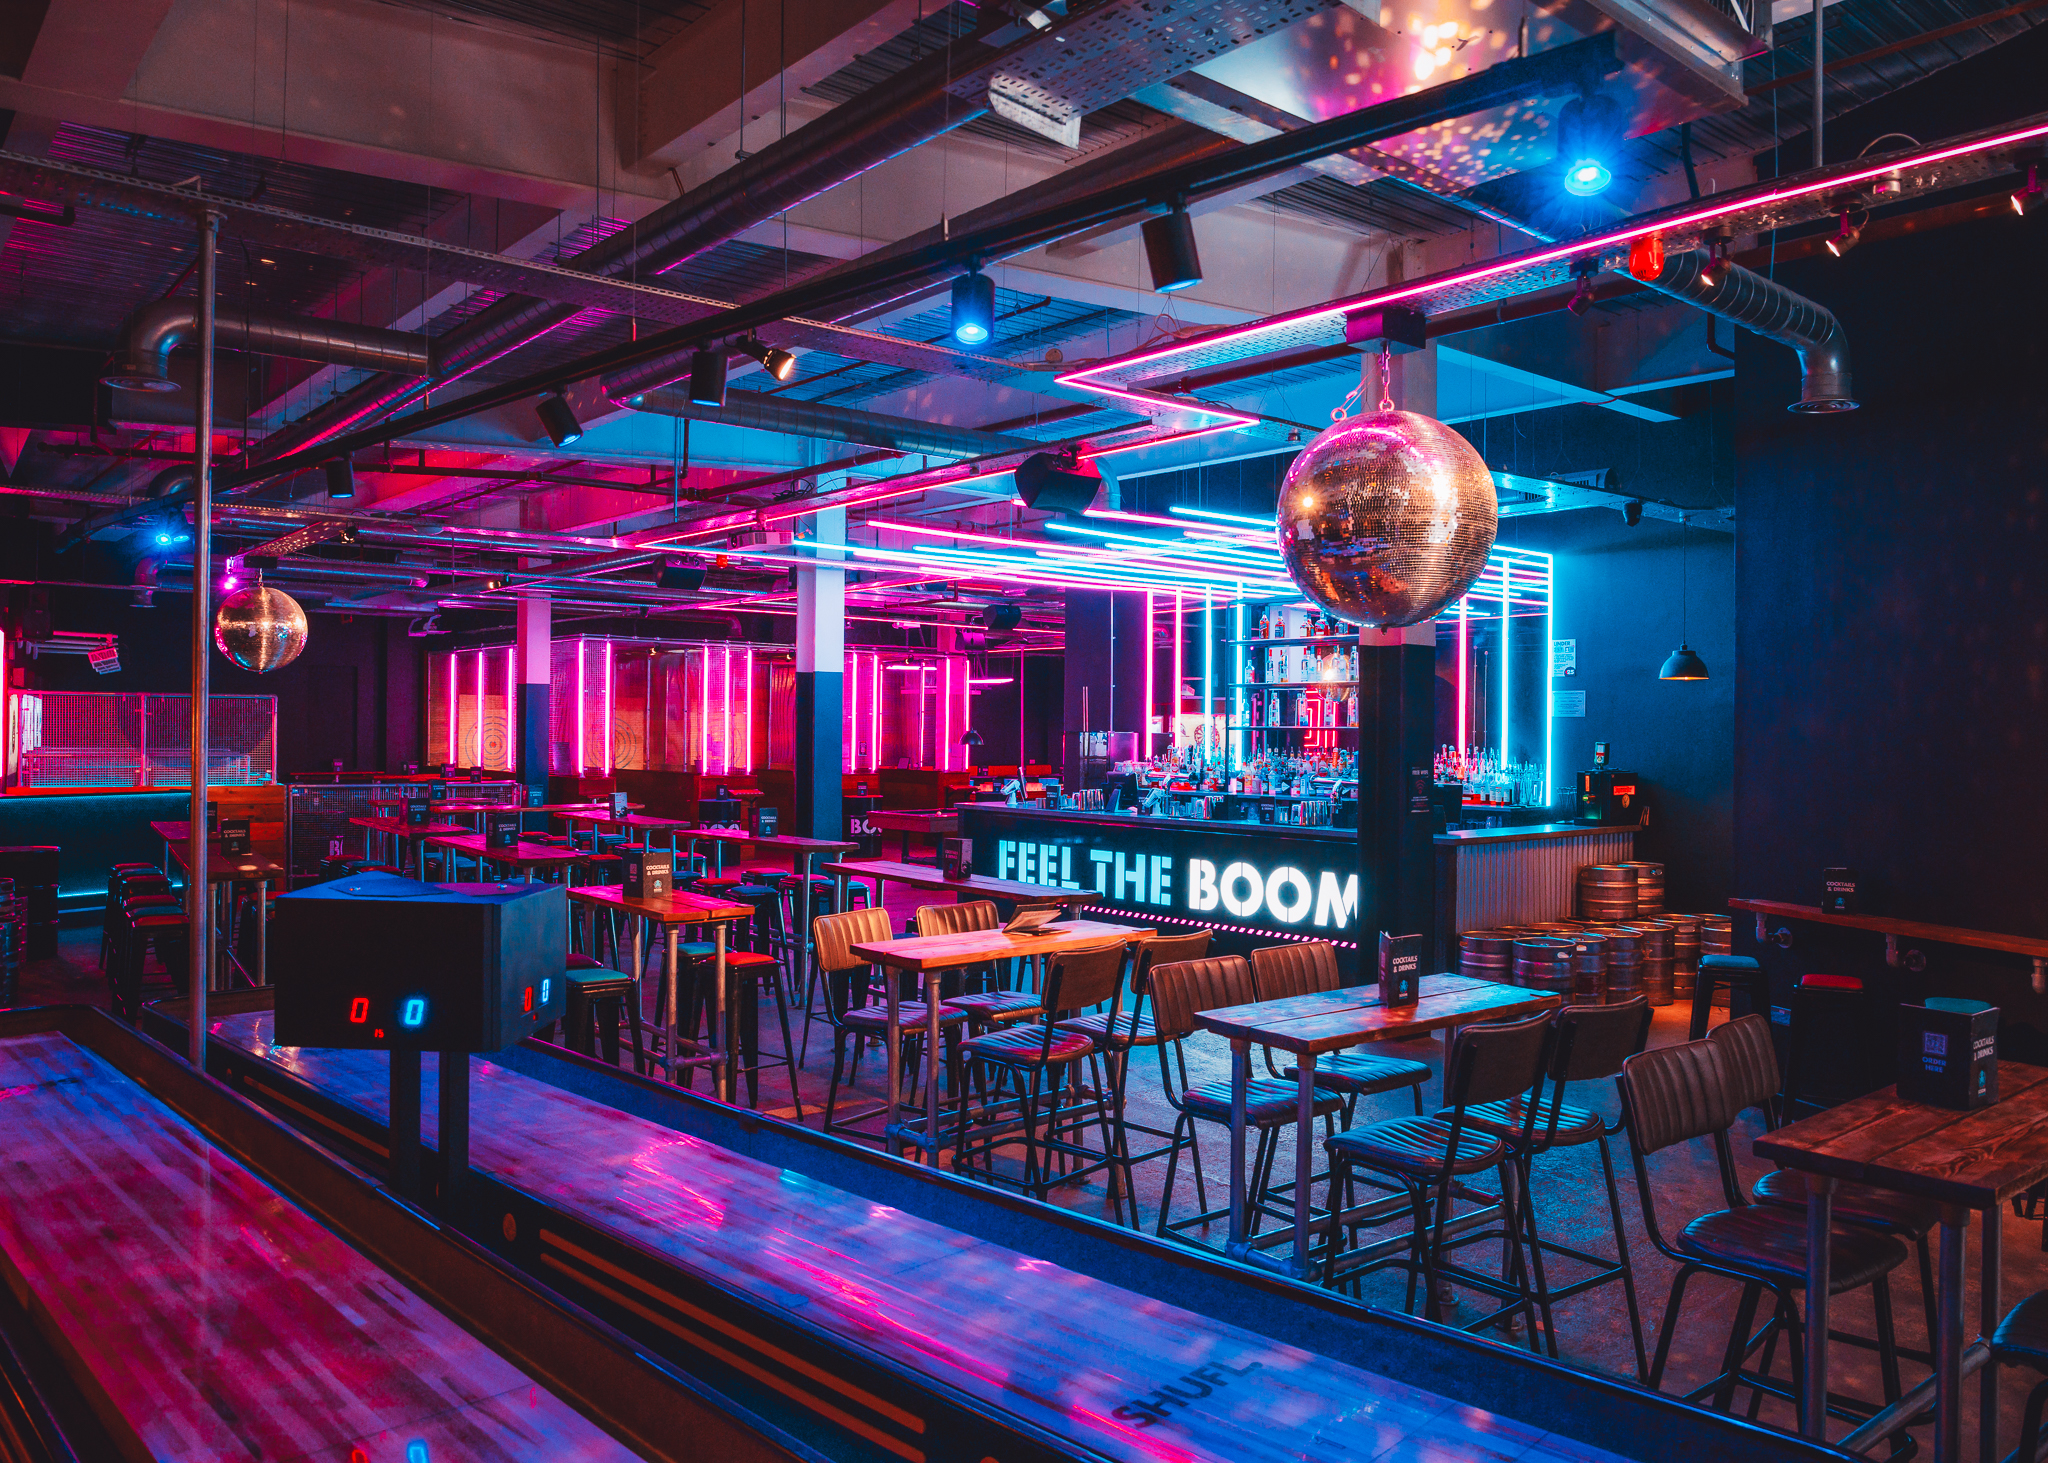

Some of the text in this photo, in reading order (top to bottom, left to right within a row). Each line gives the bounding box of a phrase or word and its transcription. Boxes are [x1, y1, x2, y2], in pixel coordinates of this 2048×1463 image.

[998, 840, 1358, 929] FEEL THE BOOM
[1393, 956, 1418, 964] COCKTAILS
[1398, 963, 1416, 972] DRINKS
[350, 998, 425, 1025] 0 0
[1922, 1057, 1946, 1066] ORDER
[1925, 1064, 1943, 1073] HERE
